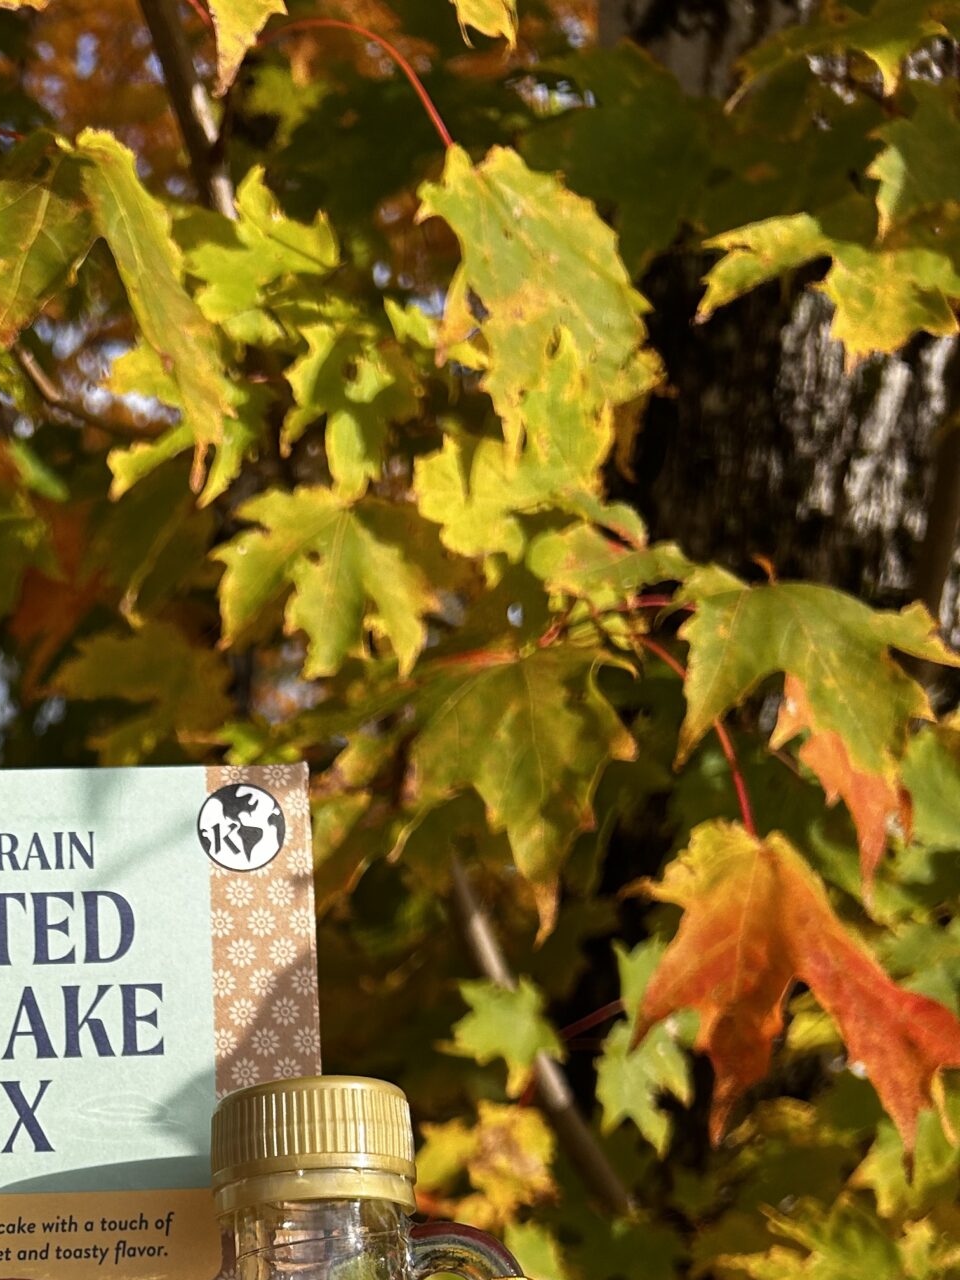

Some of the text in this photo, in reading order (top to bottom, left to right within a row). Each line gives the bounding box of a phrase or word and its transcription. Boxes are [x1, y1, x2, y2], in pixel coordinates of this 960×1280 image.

[42, 1214, 78, 1233] with
[84, 1220, 94, 1232] a
[100, 1213, 149, 1232] touch
[155, 1212, 174, 1236] of
[17, 1242, 50, 1261] and
[55, 1241, 109, 1265] toasty
[115, 1240, 168, 1264] flavor.
